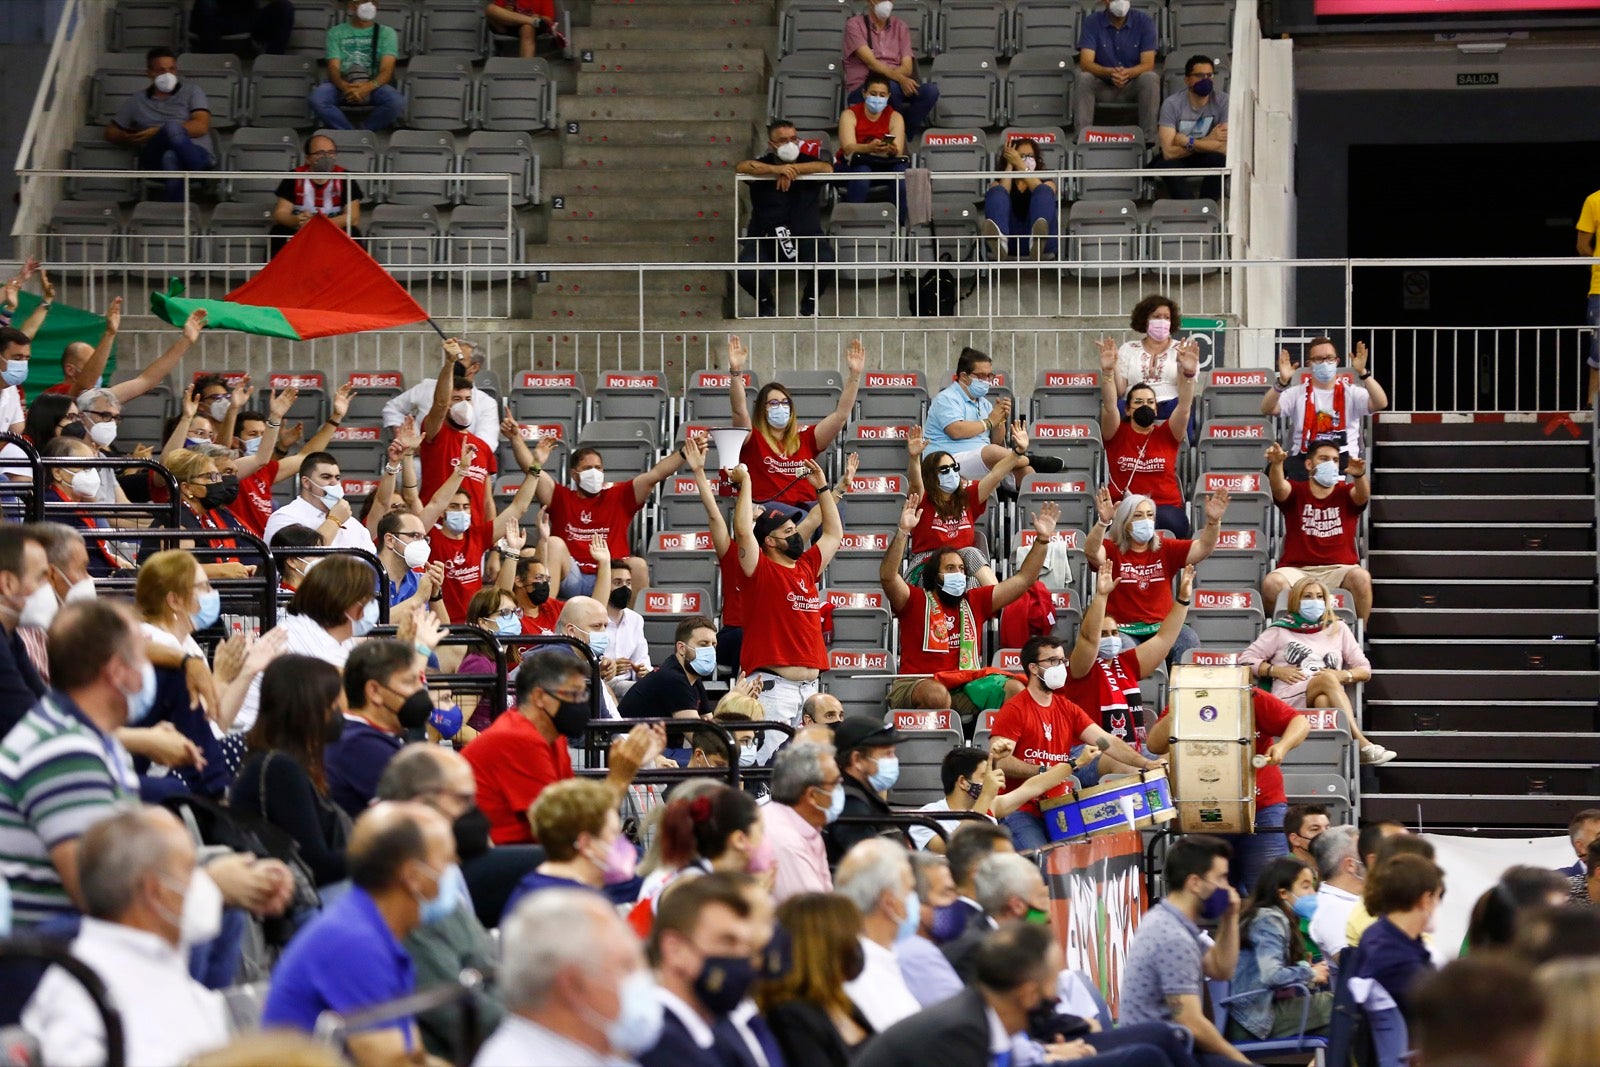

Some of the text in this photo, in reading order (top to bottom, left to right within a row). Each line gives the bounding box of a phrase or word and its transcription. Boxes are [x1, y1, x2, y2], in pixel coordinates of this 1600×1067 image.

[584, 52, 592, 61] 4
[1459, 73, 1498, 84] SALIDA
[569, 124, 577, 132] 3
[929, 138, 969, 147] NO USAR
[1089, 135, 1129, 145] NO USAR
[555, 198, 563, 207] 2
[1216, 320, 1224, 332] 2
[274, 378, 289, 387] NO
[353, 377, 397, 387] NO USAR
[528, 378, 572, 387] NO USAR
[610, 378, 654, 388] NO USAR
[704, 378, 746, 387] NO USR
[870, 376, 913, 386] NO USAR
[1050, 376, 1094, 386] NO USAR
[1216, 375, 1260, 384] NO USAR
[350, 431, 377, 441] USAR
[519, 428, 528, 437] O
[862, 429, 876, 438] NO
[1040, 428, 1084, 438] NO USAR
[1214, 428, 1259, 438] NO USAR
[679, 482, 694, 492] NO
[851, 480, 866, 490] NO
[1209, 478, 1224, 488] NO
[664, 536, 709, 547] NO UAR
[840, 538, 852, 548] NO
[1049, 534, 1072, 545] SAR
[1222, 536, 1252, 545] USR
[650, 596, 696, 606] NO UAR
[831, 596, 846, 606] NO
[849, 596, 876, 606] UAR
[1200, 594, 1246, 606] NO USR
[836, 656, 850, 666] NO
[1004, 656, 1020, 666] NO
[1196, 656, 1212, 665] NO
[898, 716, 946, 726] NO UAR
